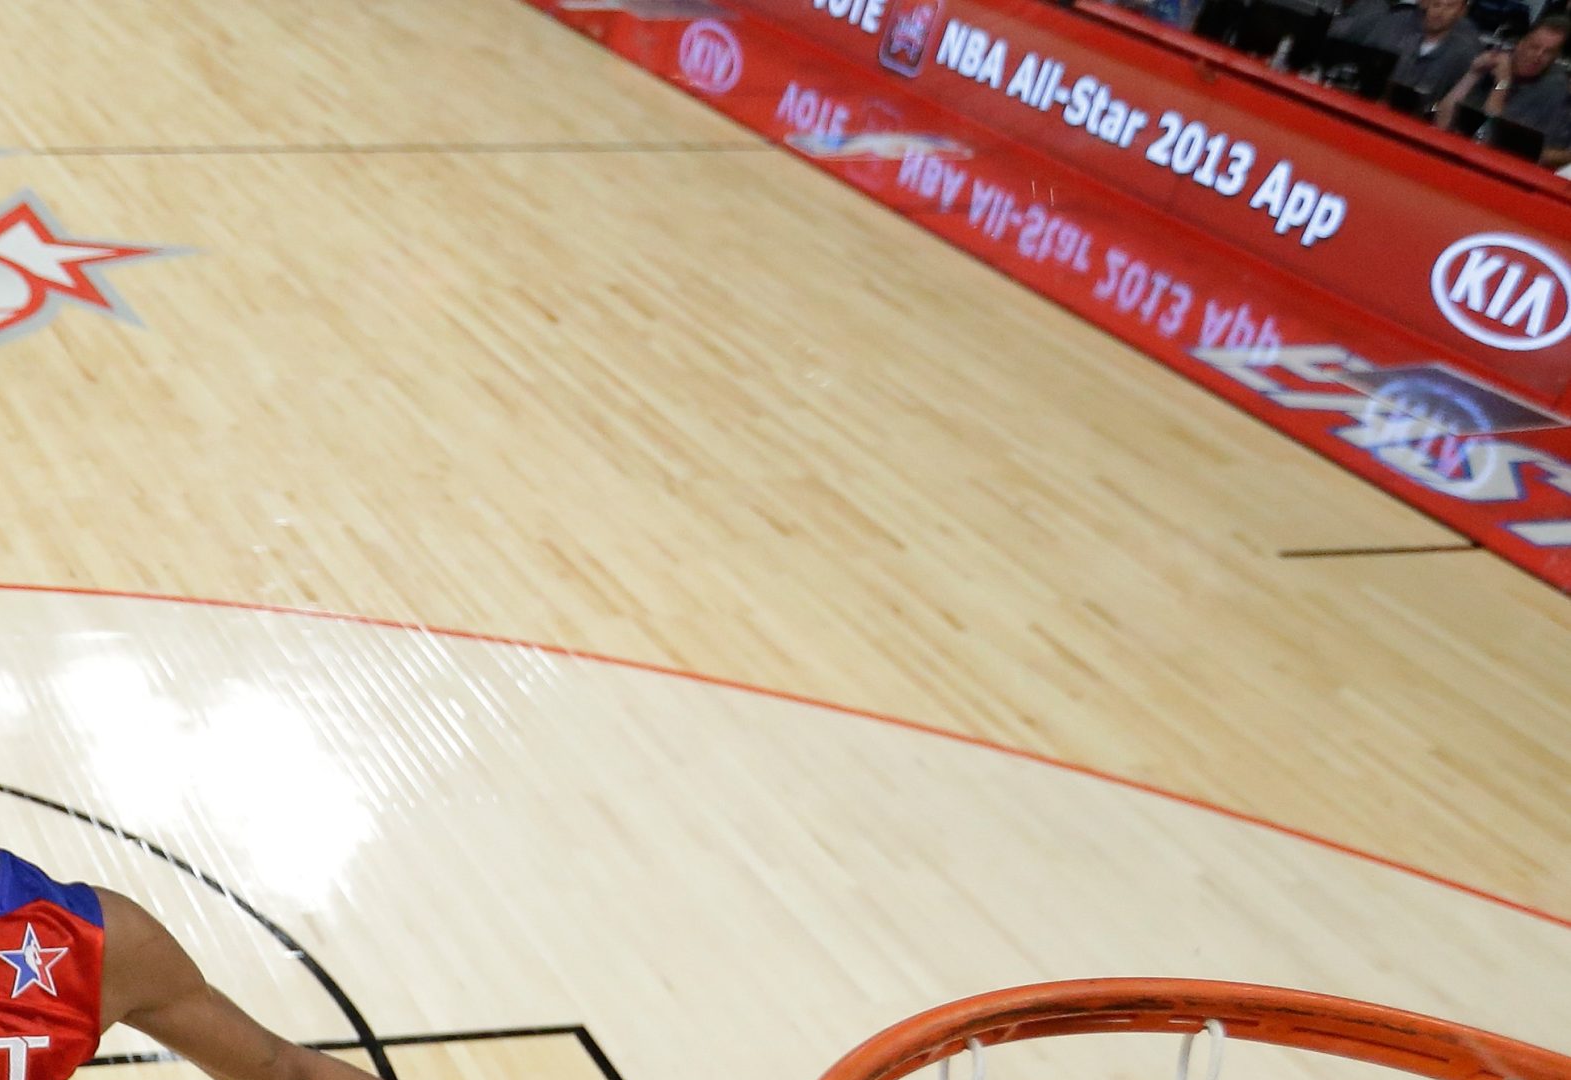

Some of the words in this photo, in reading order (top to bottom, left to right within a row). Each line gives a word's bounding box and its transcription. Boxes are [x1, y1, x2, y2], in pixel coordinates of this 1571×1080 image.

[814, 0, 883, 33] OTE
[936, 18, 1008, 89] NBA
[1006, 52, 1149, 149] All-Star
[1146, 110, 1256, 196] 2013
[1249, 160, 1347, 247] App
[1449, 247, 1556, 338] KIA
